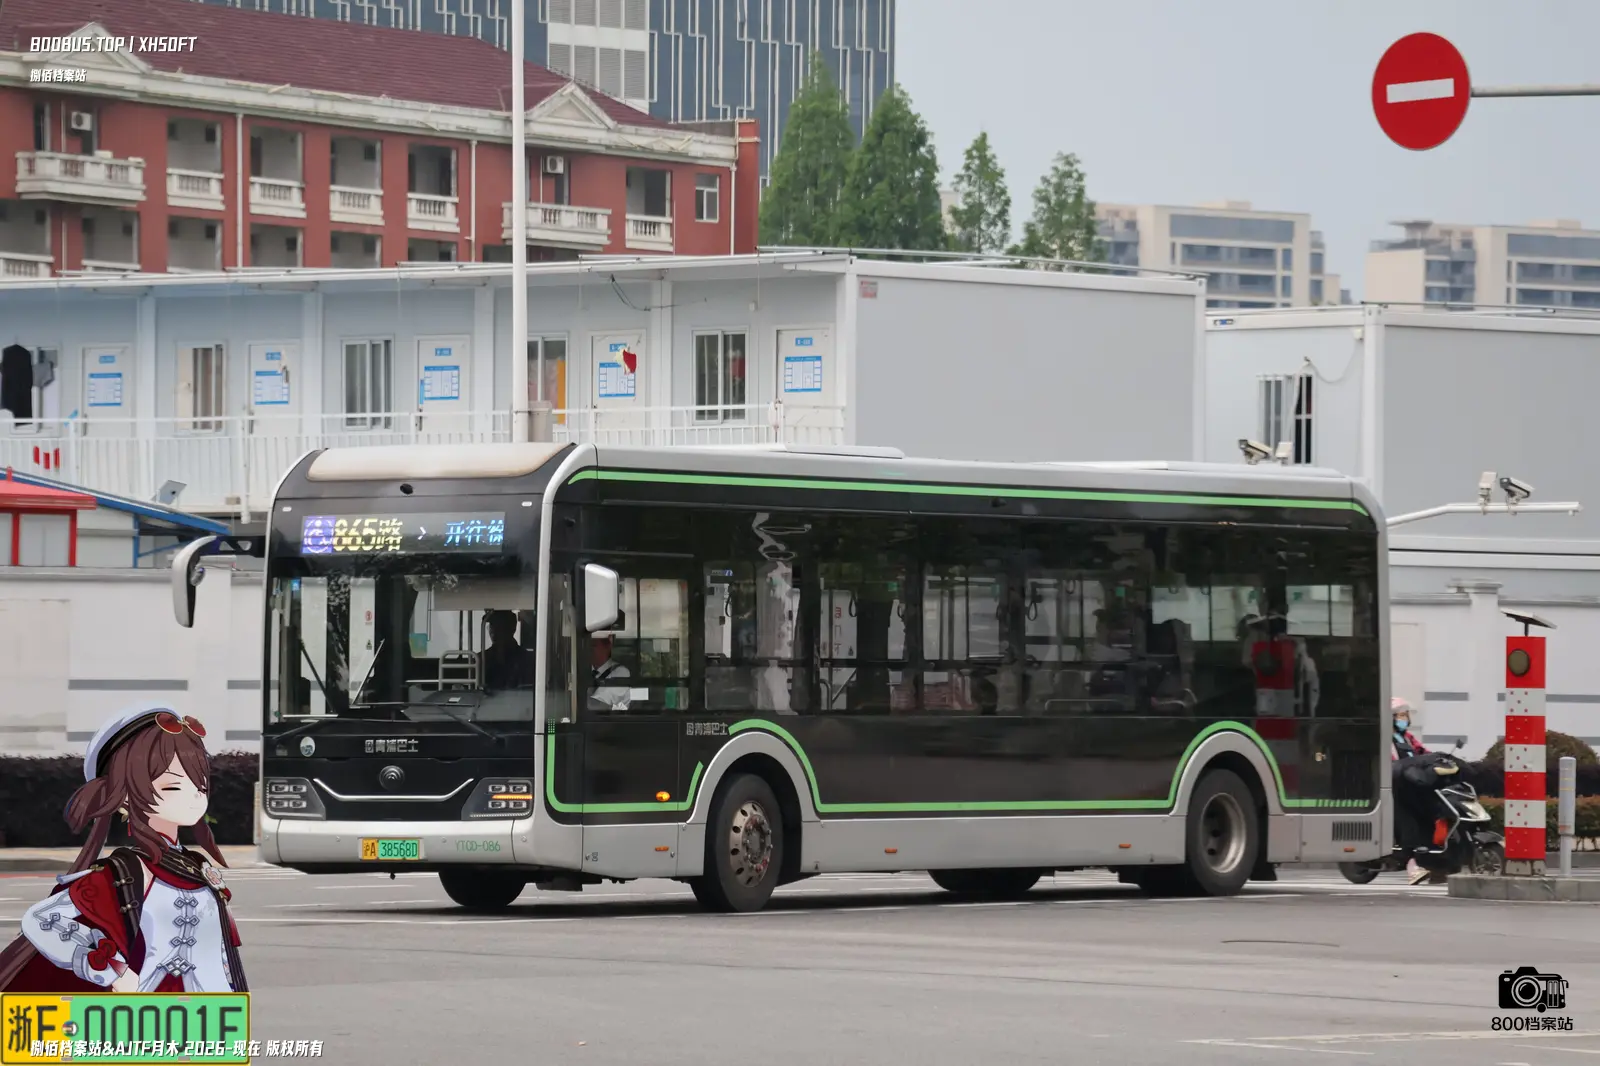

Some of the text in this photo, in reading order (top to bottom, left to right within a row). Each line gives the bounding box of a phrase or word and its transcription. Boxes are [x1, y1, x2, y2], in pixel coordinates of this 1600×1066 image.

[375, 739, 419, 752] 青浦巴士
[381, 842, 418, 857] 38568D
